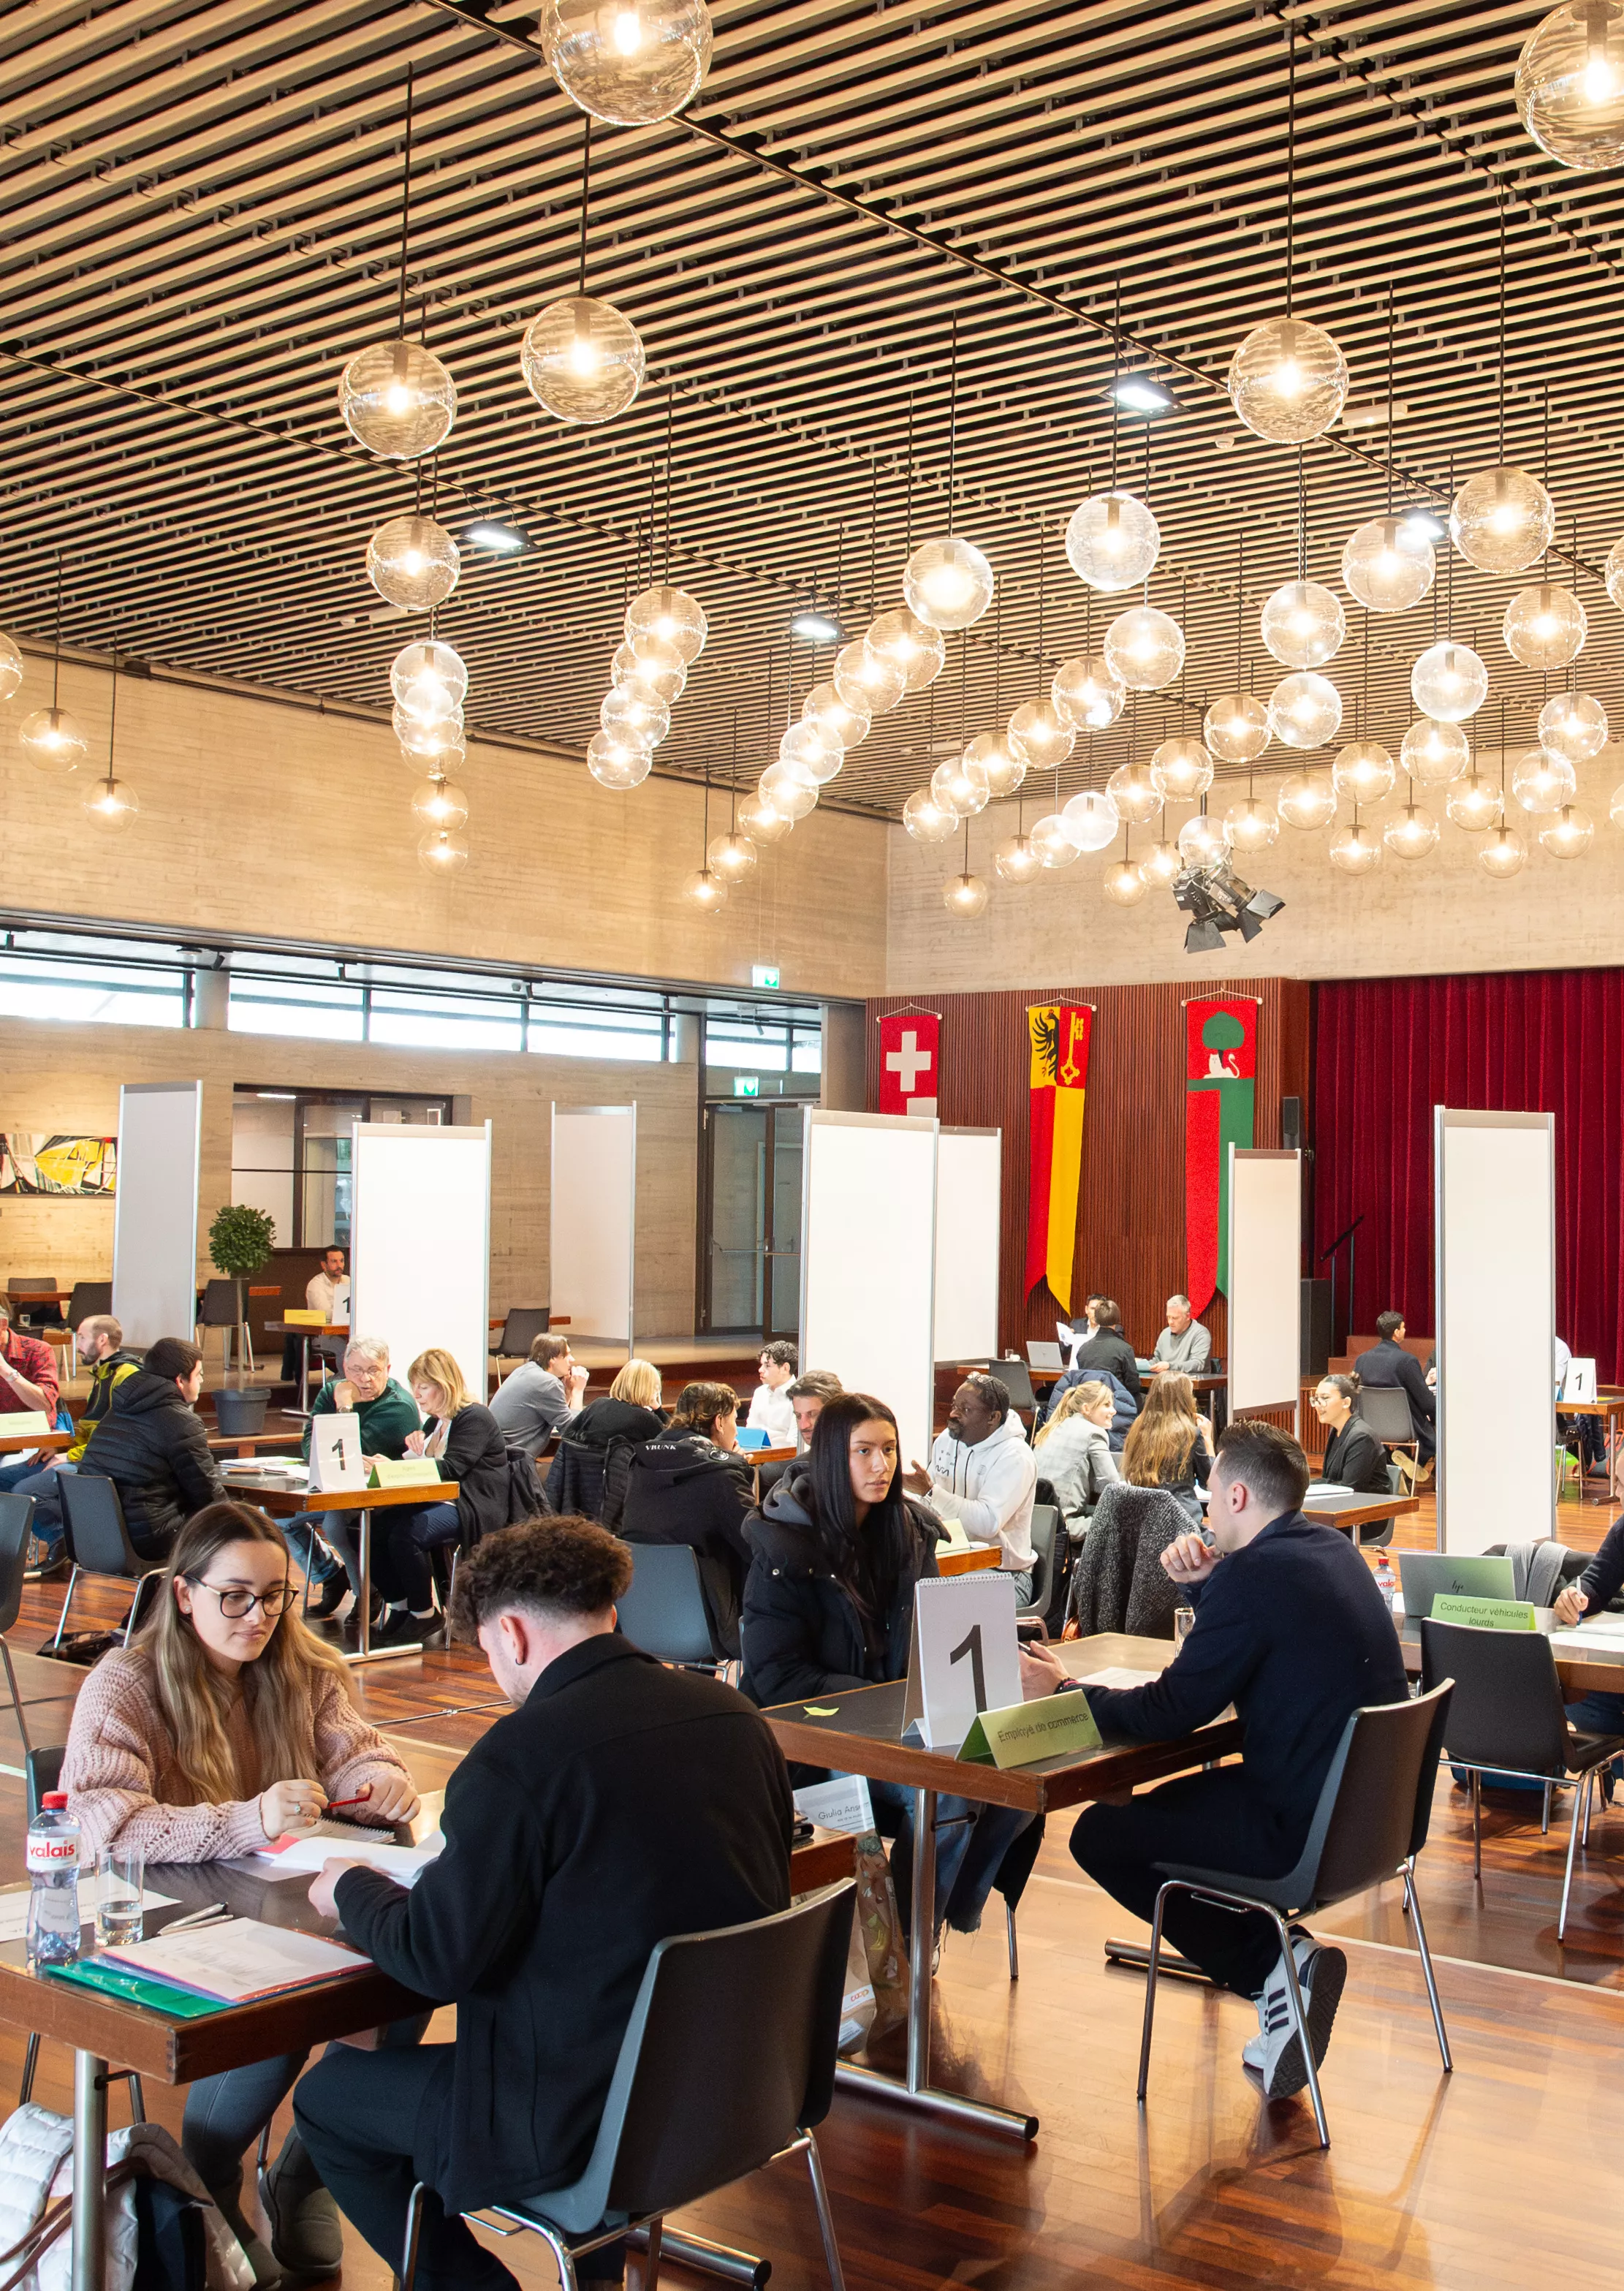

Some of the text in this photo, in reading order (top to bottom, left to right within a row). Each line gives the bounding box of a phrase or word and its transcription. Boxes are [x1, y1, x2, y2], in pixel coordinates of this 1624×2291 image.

[342, 1296, 350, 1314] 1
[1575, 1373, 1582, 1390] 1
[332, 1439, 346, 1470] 1
[1440, 1602, 1529, 1619] Conducteur véhicules
[1468, 1616, 1495, 1627] lourds
[950, 1624, 987, 1713] 1
[1047, 1711, 1089, 1730] commerce
[818, 1808, 843, 1820] Giulia
[29, 1841, 75, 1858] valais
[850, 1989, 870, 2002] coop
